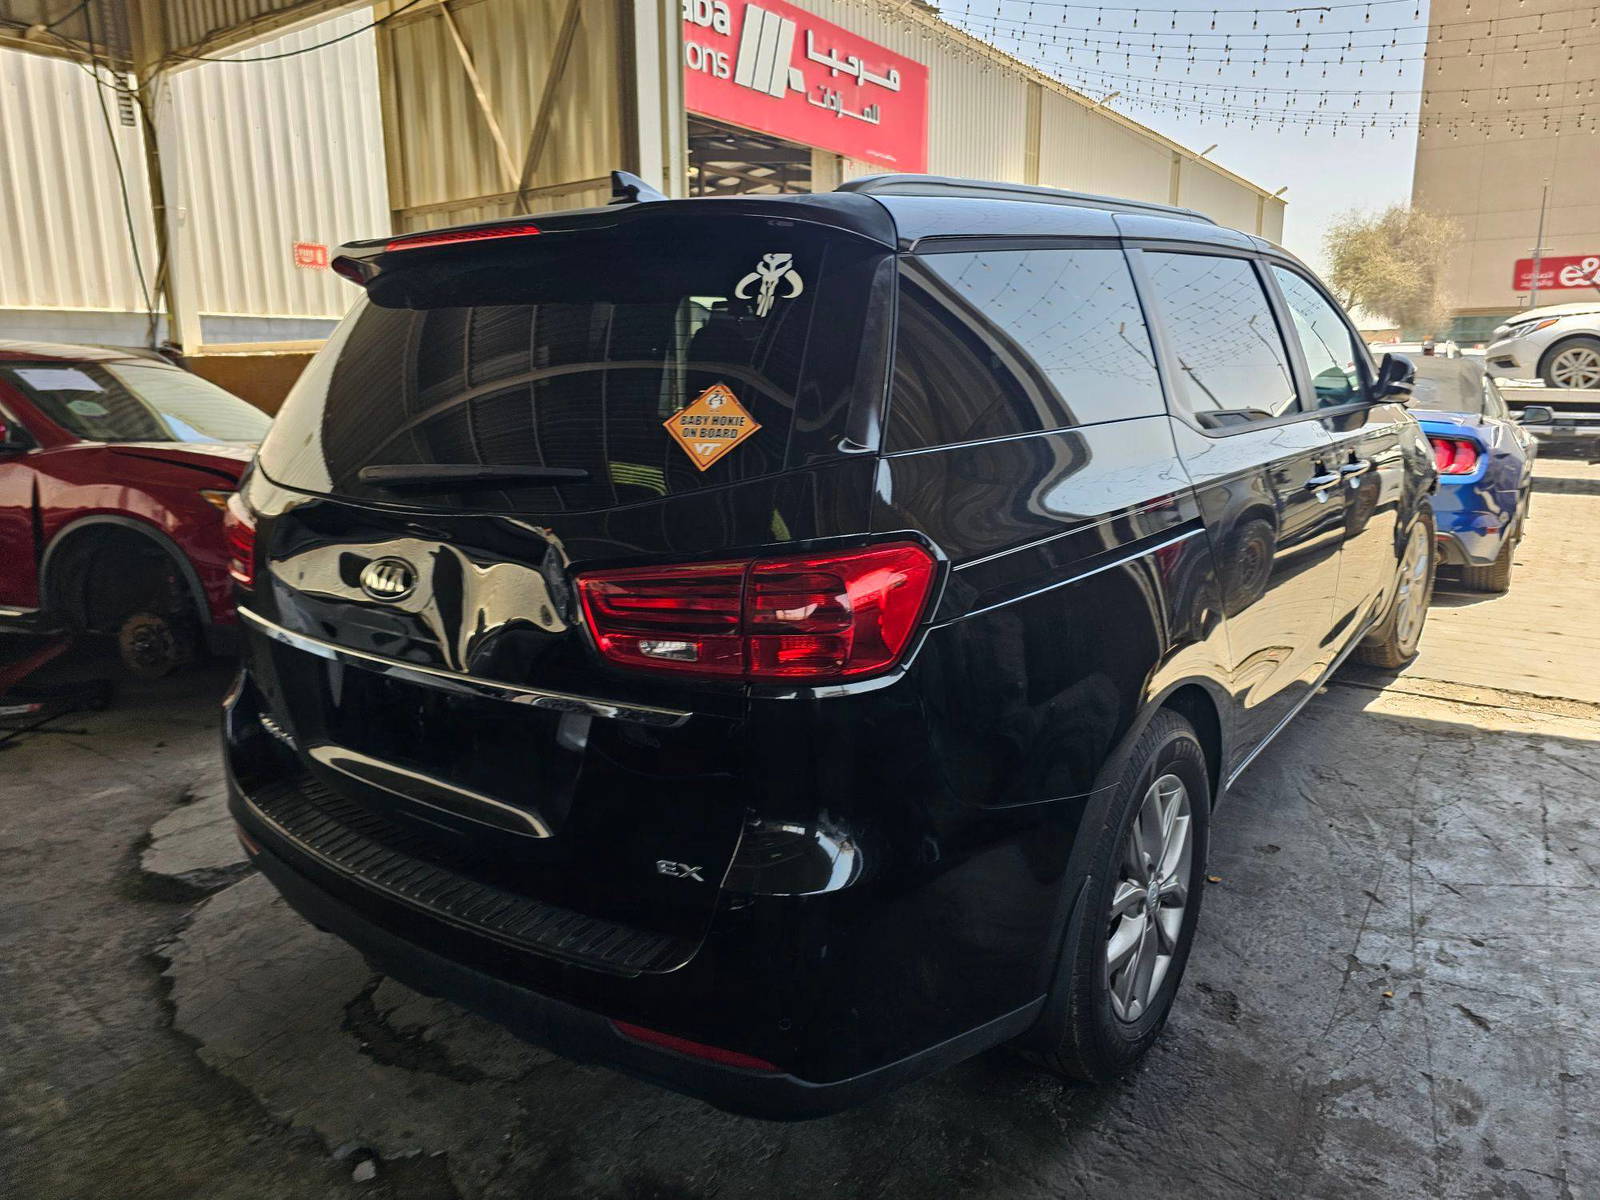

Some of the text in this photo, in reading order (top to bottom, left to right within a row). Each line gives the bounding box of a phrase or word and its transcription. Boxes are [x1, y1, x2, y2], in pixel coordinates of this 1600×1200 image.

[686, 42, 731, 79] ons
[807, 28, 901, 91] مرحبا
[681, 415, 745, 427] BABY HOKIE
[682, 427, 738, 439] ON BOARD
[363, 563, 408, 594] KIA
[656, 859, 704, 882] EX
